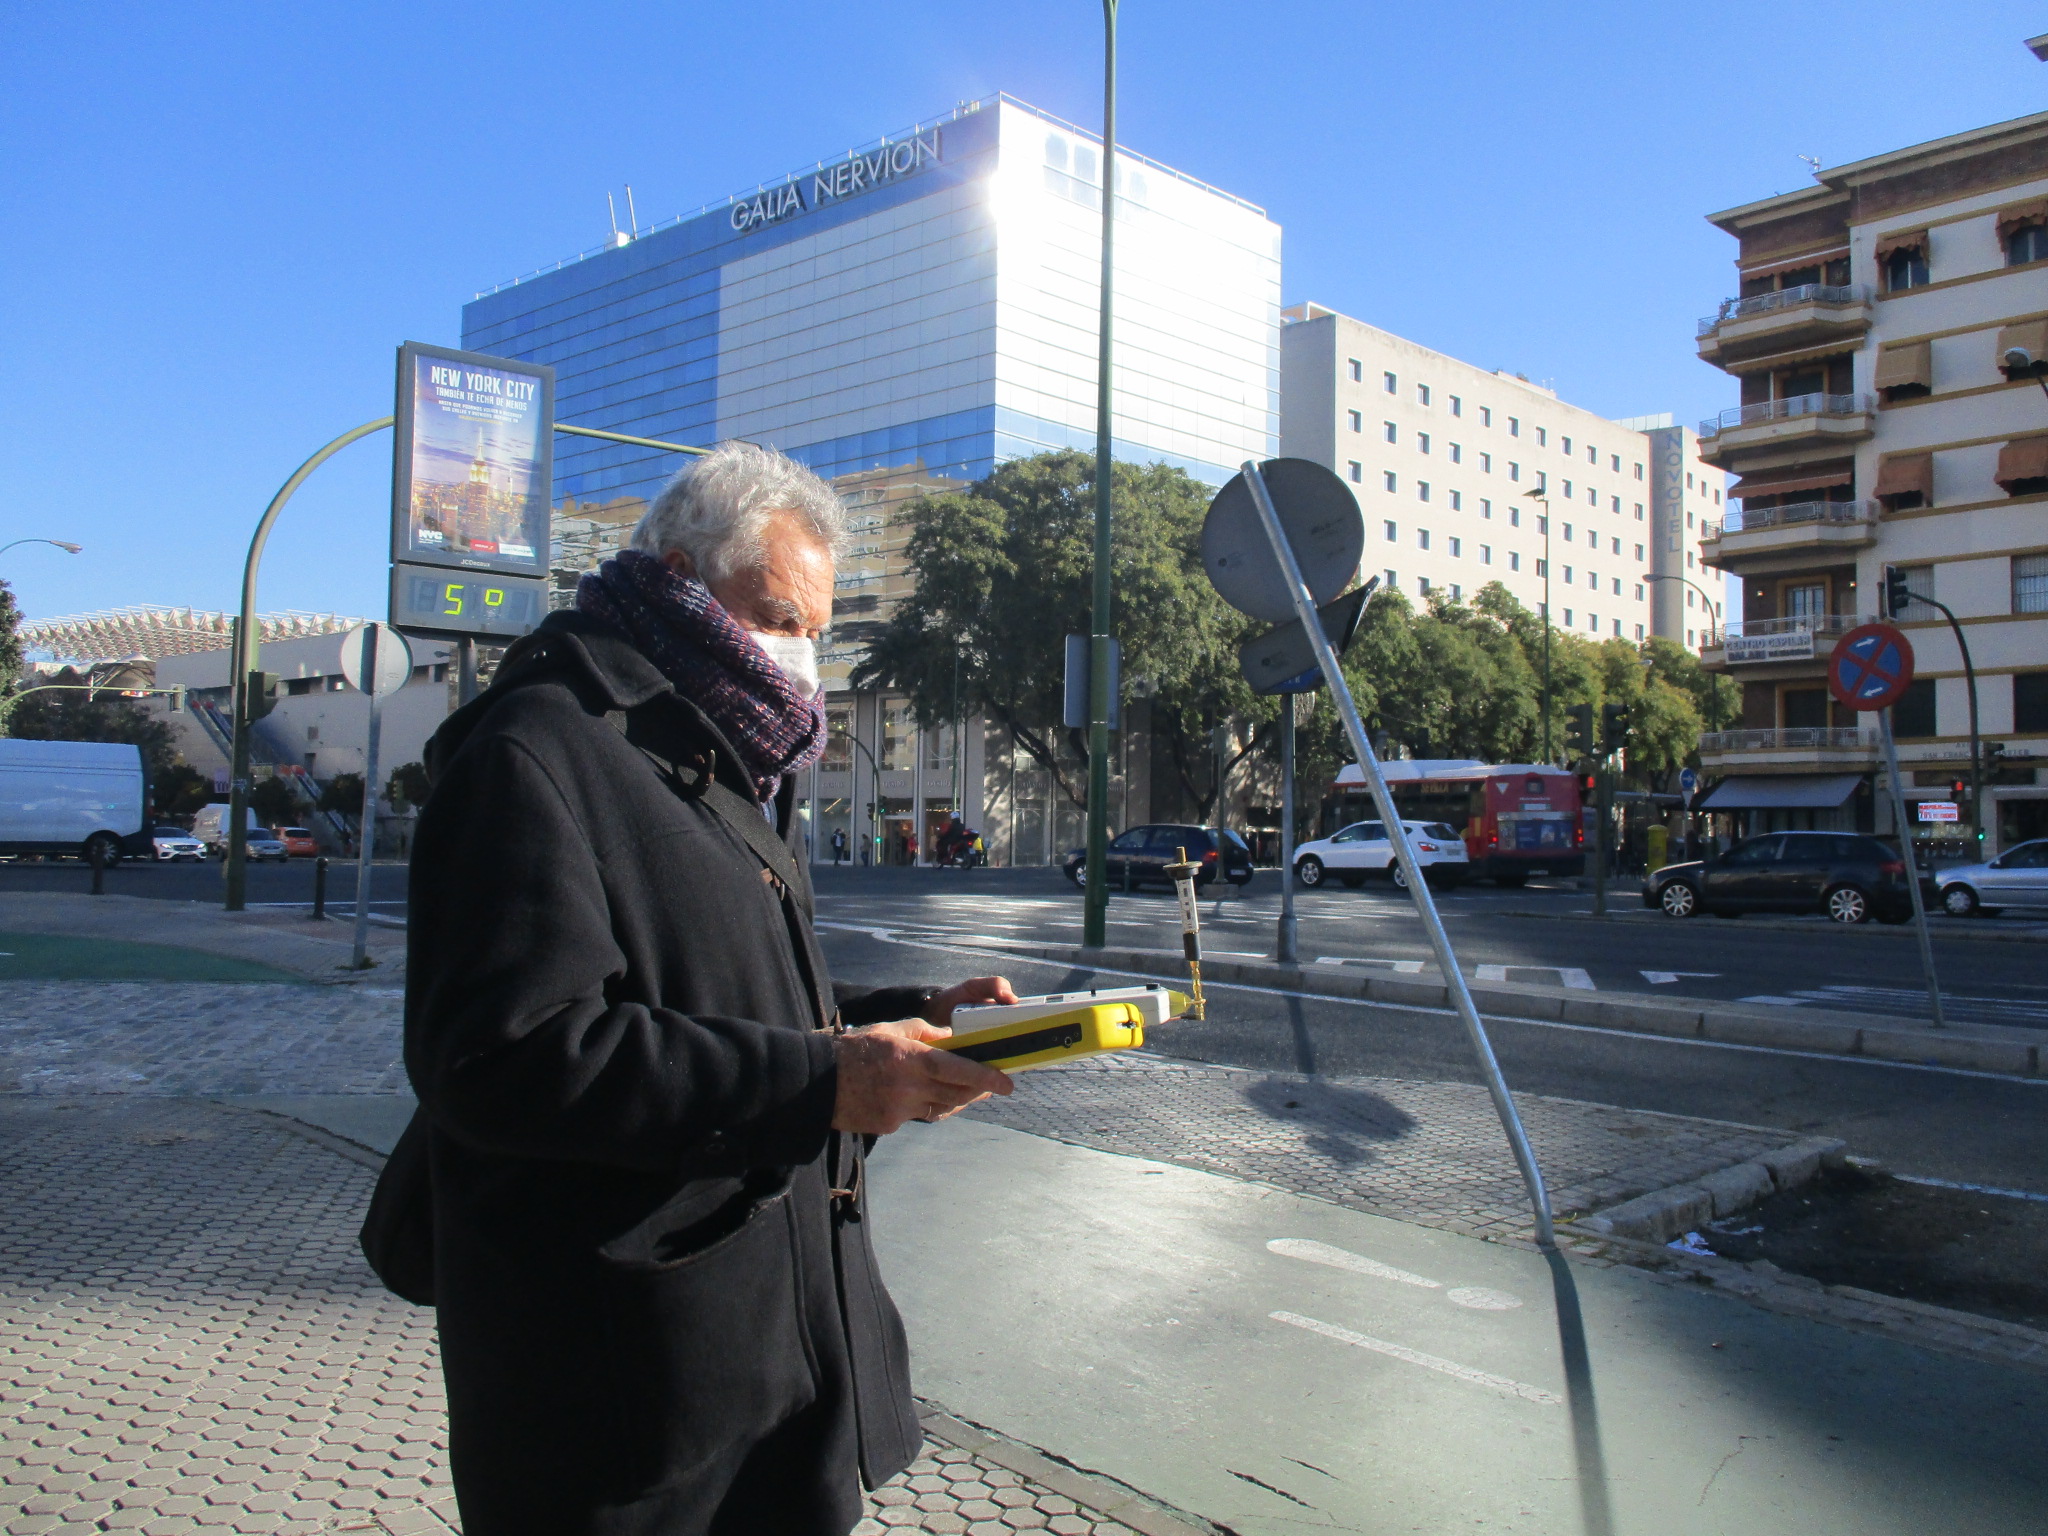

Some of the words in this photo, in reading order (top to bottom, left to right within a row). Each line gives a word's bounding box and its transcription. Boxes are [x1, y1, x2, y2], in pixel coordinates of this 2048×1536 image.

[731, 183, 800, 231] GALIA
[431, 366, 461, 387] NEW
[466, 372, 501, 395] YORK
[506, 380, 534, 401] CITY
[436, 387, 464, 400] TAMBIÉN
[467, 392, 474, 401] TE
[476, 394, 493, 405] ECHA
[496, 397, 503, 406] DE
[505, 399, 527, 411] MENOS
[1666, 432, 1682, 553] NOVOTEL
[418, 529, 443, 540] NYC
